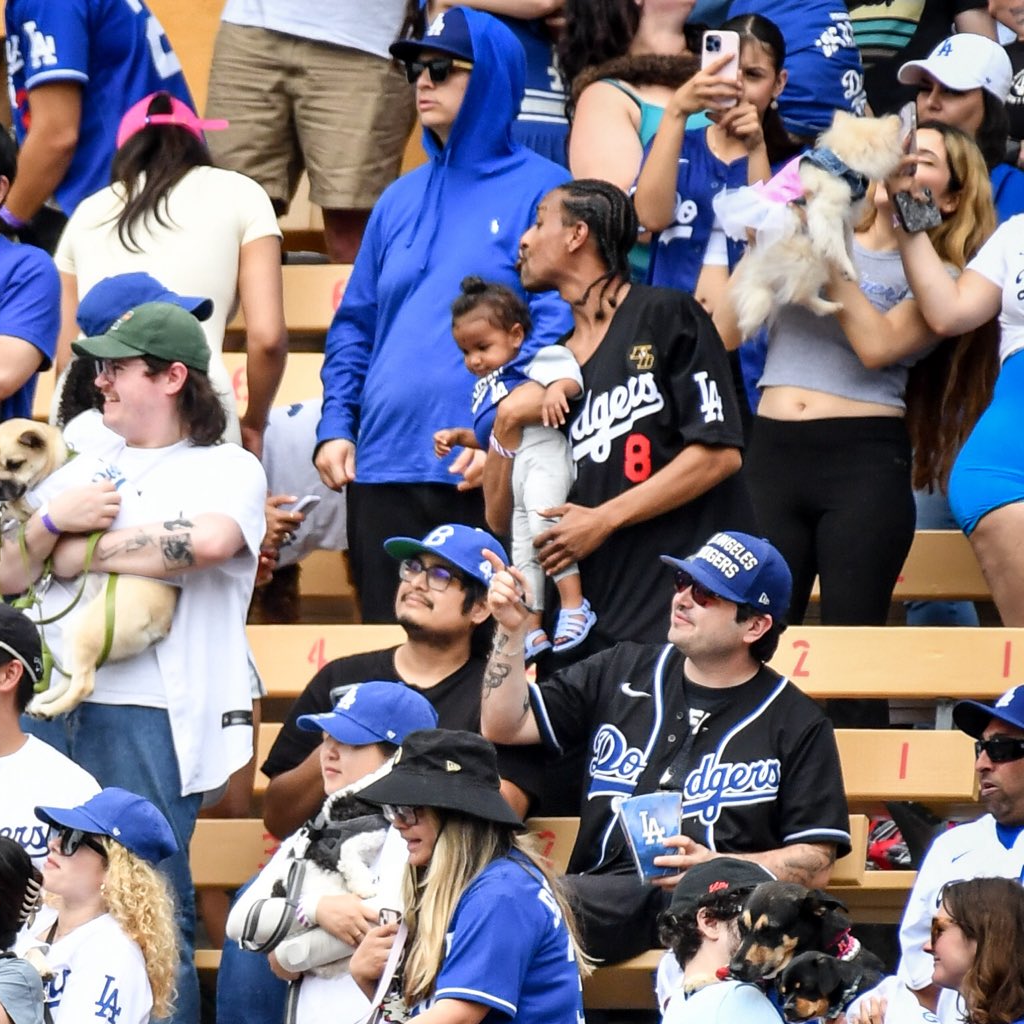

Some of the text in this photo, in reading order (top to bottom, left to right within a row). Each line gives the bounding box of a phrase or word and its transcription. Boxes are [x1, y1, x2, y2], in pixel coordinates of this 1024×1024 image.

[23, 20, 58, 69] LA
[693, 371, 725, 422] LA
[624, 432, 651, 483] 8
[422, 525, 455, 547] B
[307, 637, 325, 673] 4
[792, 639, 810, 677] 2
[1002, 640, 1012, 679] 1
[588, 733, 782, 823] Dodgers
[899, 742, 909, 780] 1
[639, 810, 667, 846] LA
